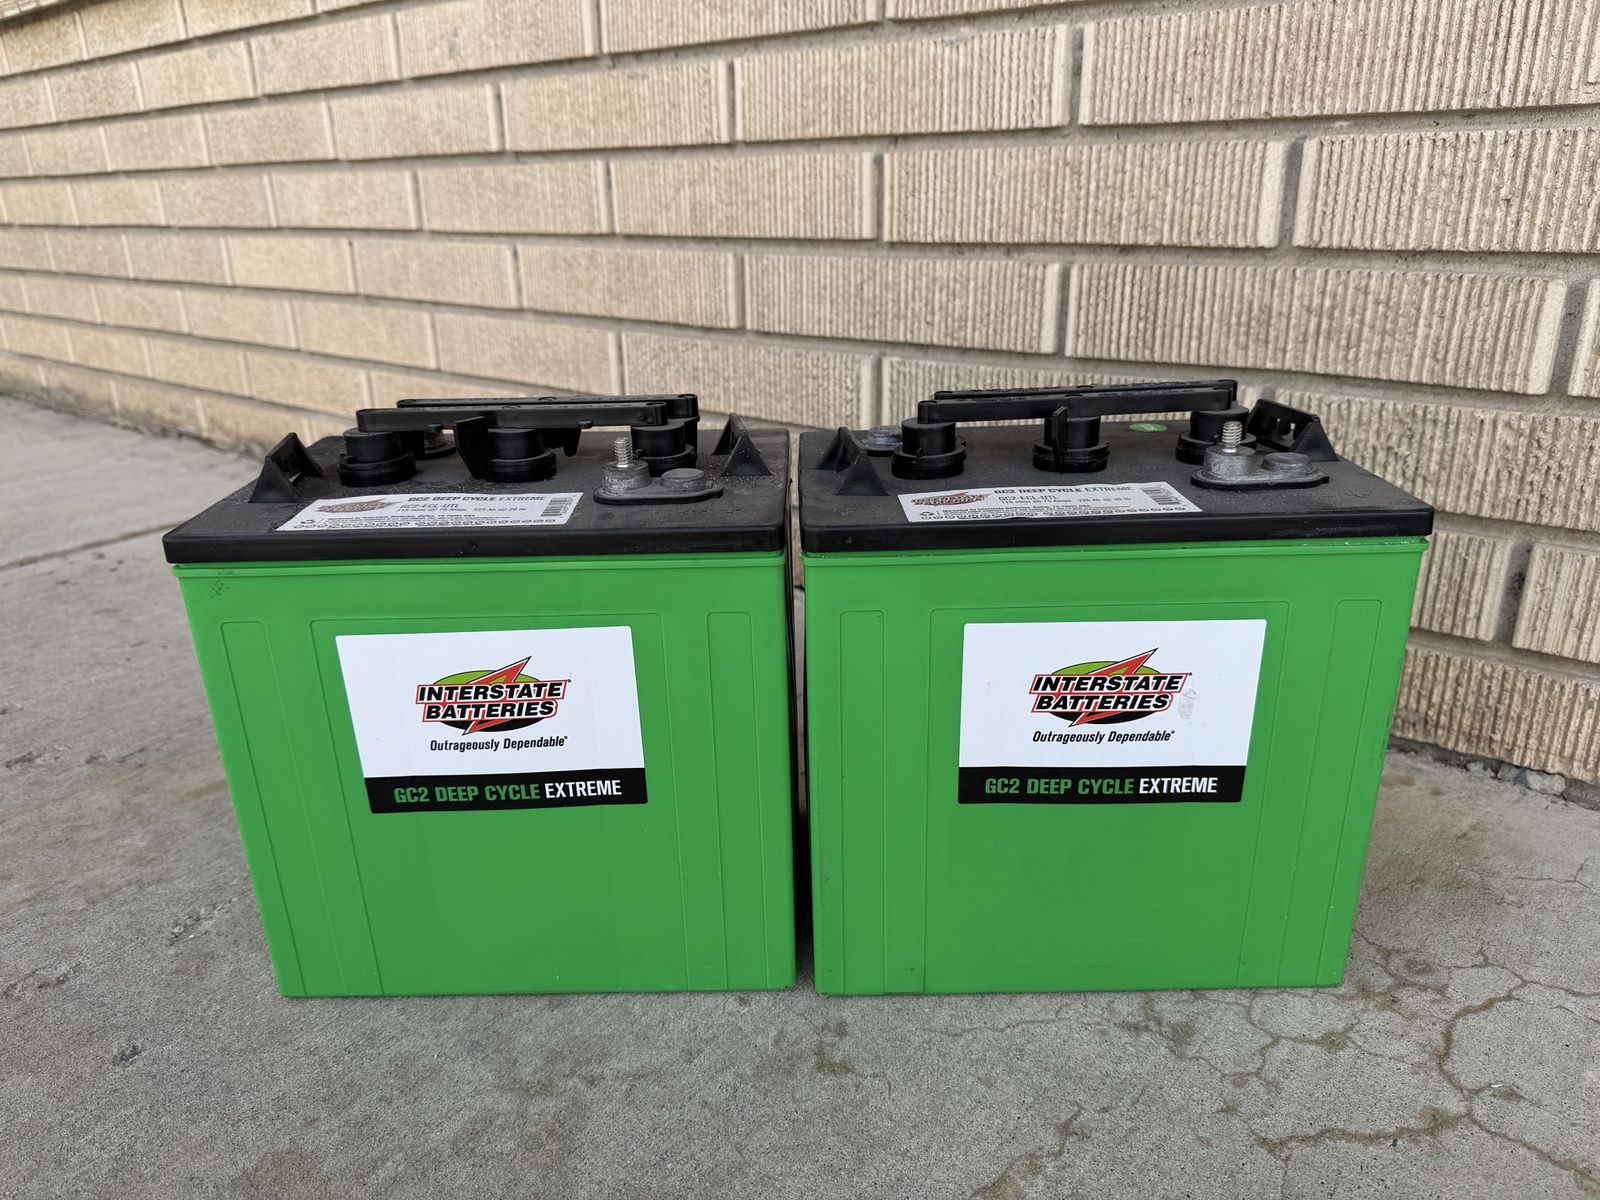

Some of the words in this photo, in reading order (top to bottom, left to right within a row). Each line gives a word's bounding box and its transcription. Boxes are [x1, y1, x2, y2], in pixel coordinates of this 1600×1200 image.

[418, 682, 563, 702] INTERSTATE
[1033, 675, 1184, 692] INTERSTATE
[425, 701, 555, 720] BATTERIES
[1036, 693, 1170, 711] BATTERIES
[430, 738, 501, 753] Outrageously
[1032, 731, 1104, 744] Outrageously
[393, 787, 430, 803] GC2
[435, 785, 479, 802] DEEP
[486, 783, 541, 801] CYCLE
[544, 779, 622, 799] EXTREME
[985, 778, 1020, 794] GC2
[1027, 778, 1072, 794] DEEP
[1077, 778, 1135, 794] CYCLE
[1139, 777, 1218, 794] EXTREME
